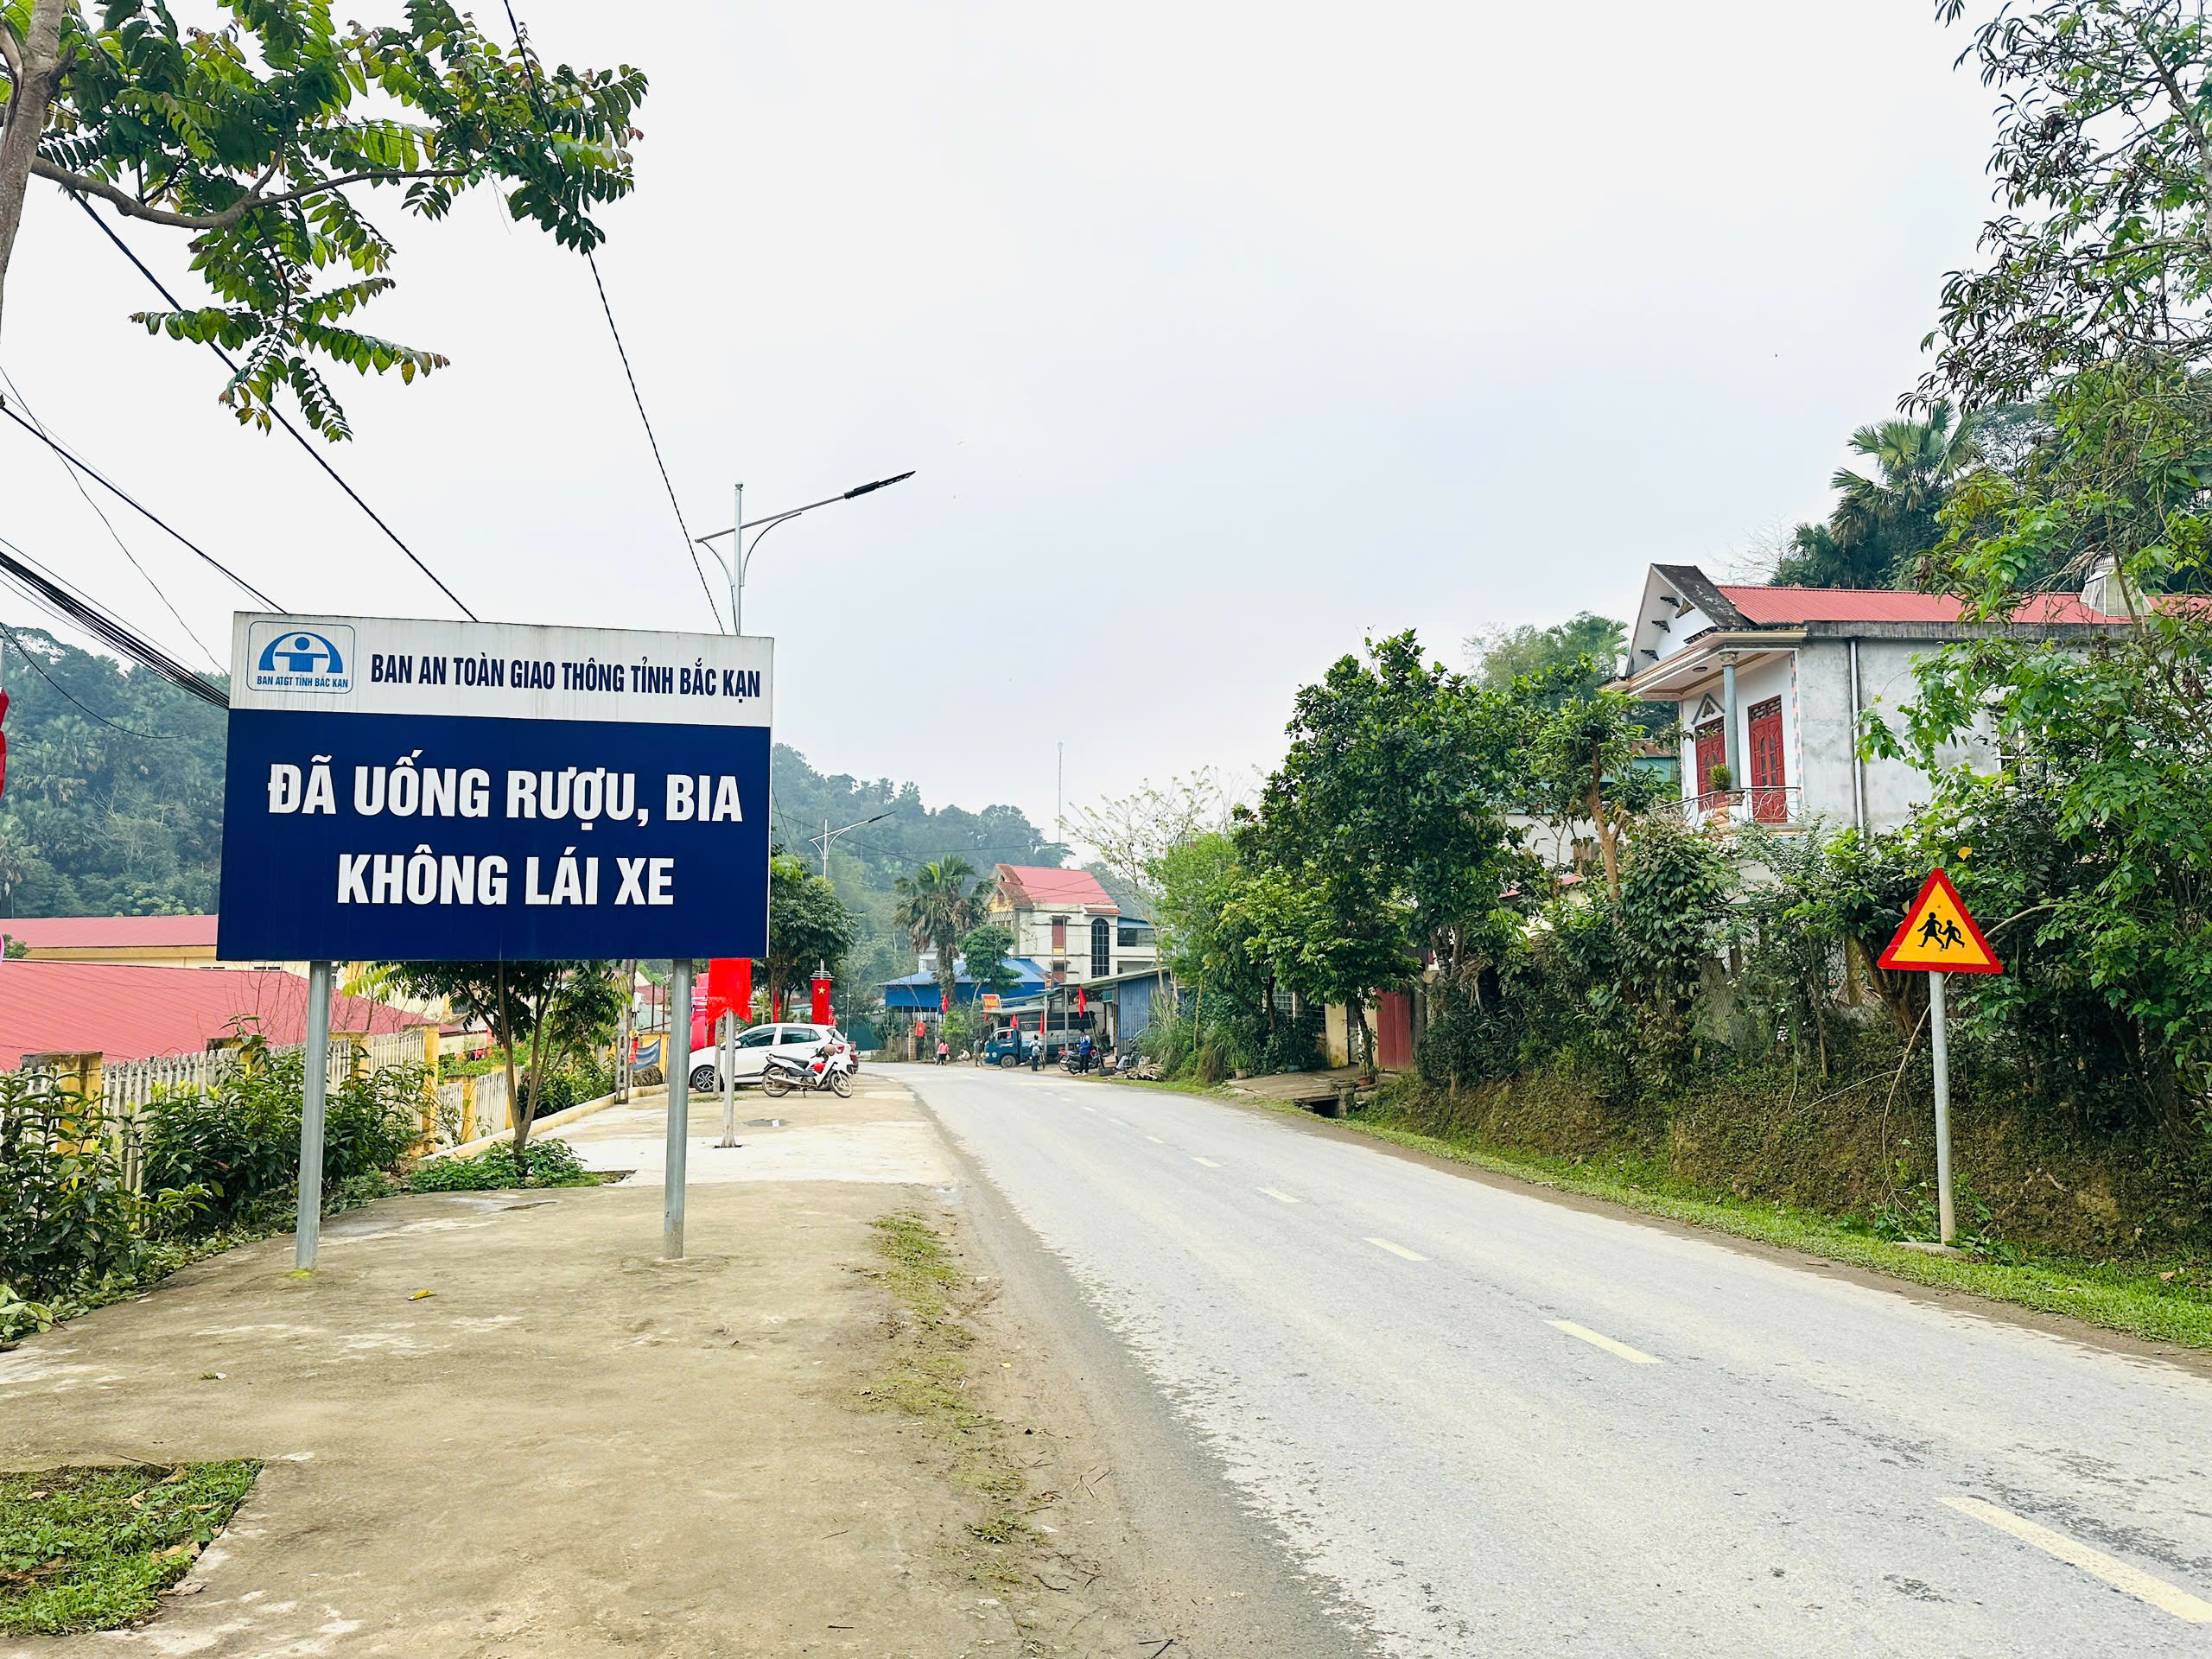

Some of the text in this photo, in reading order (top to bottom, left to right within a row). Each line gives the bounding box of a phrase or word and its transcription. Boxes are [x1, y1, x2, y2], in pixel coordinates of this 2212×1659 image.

[257, 676, 273, 685] BAN
[275, 677, 293, 686] ATGT
[371, 652, 760, 703] BAN AN TOÀN GIAO THÔNG TỈNH BẮC KẠN
[268, 750, 743, 830] ĐÃ UỐNG RƯỢU, BIA
[338, 844, 674, 905] KHÔNG LÁI XE
